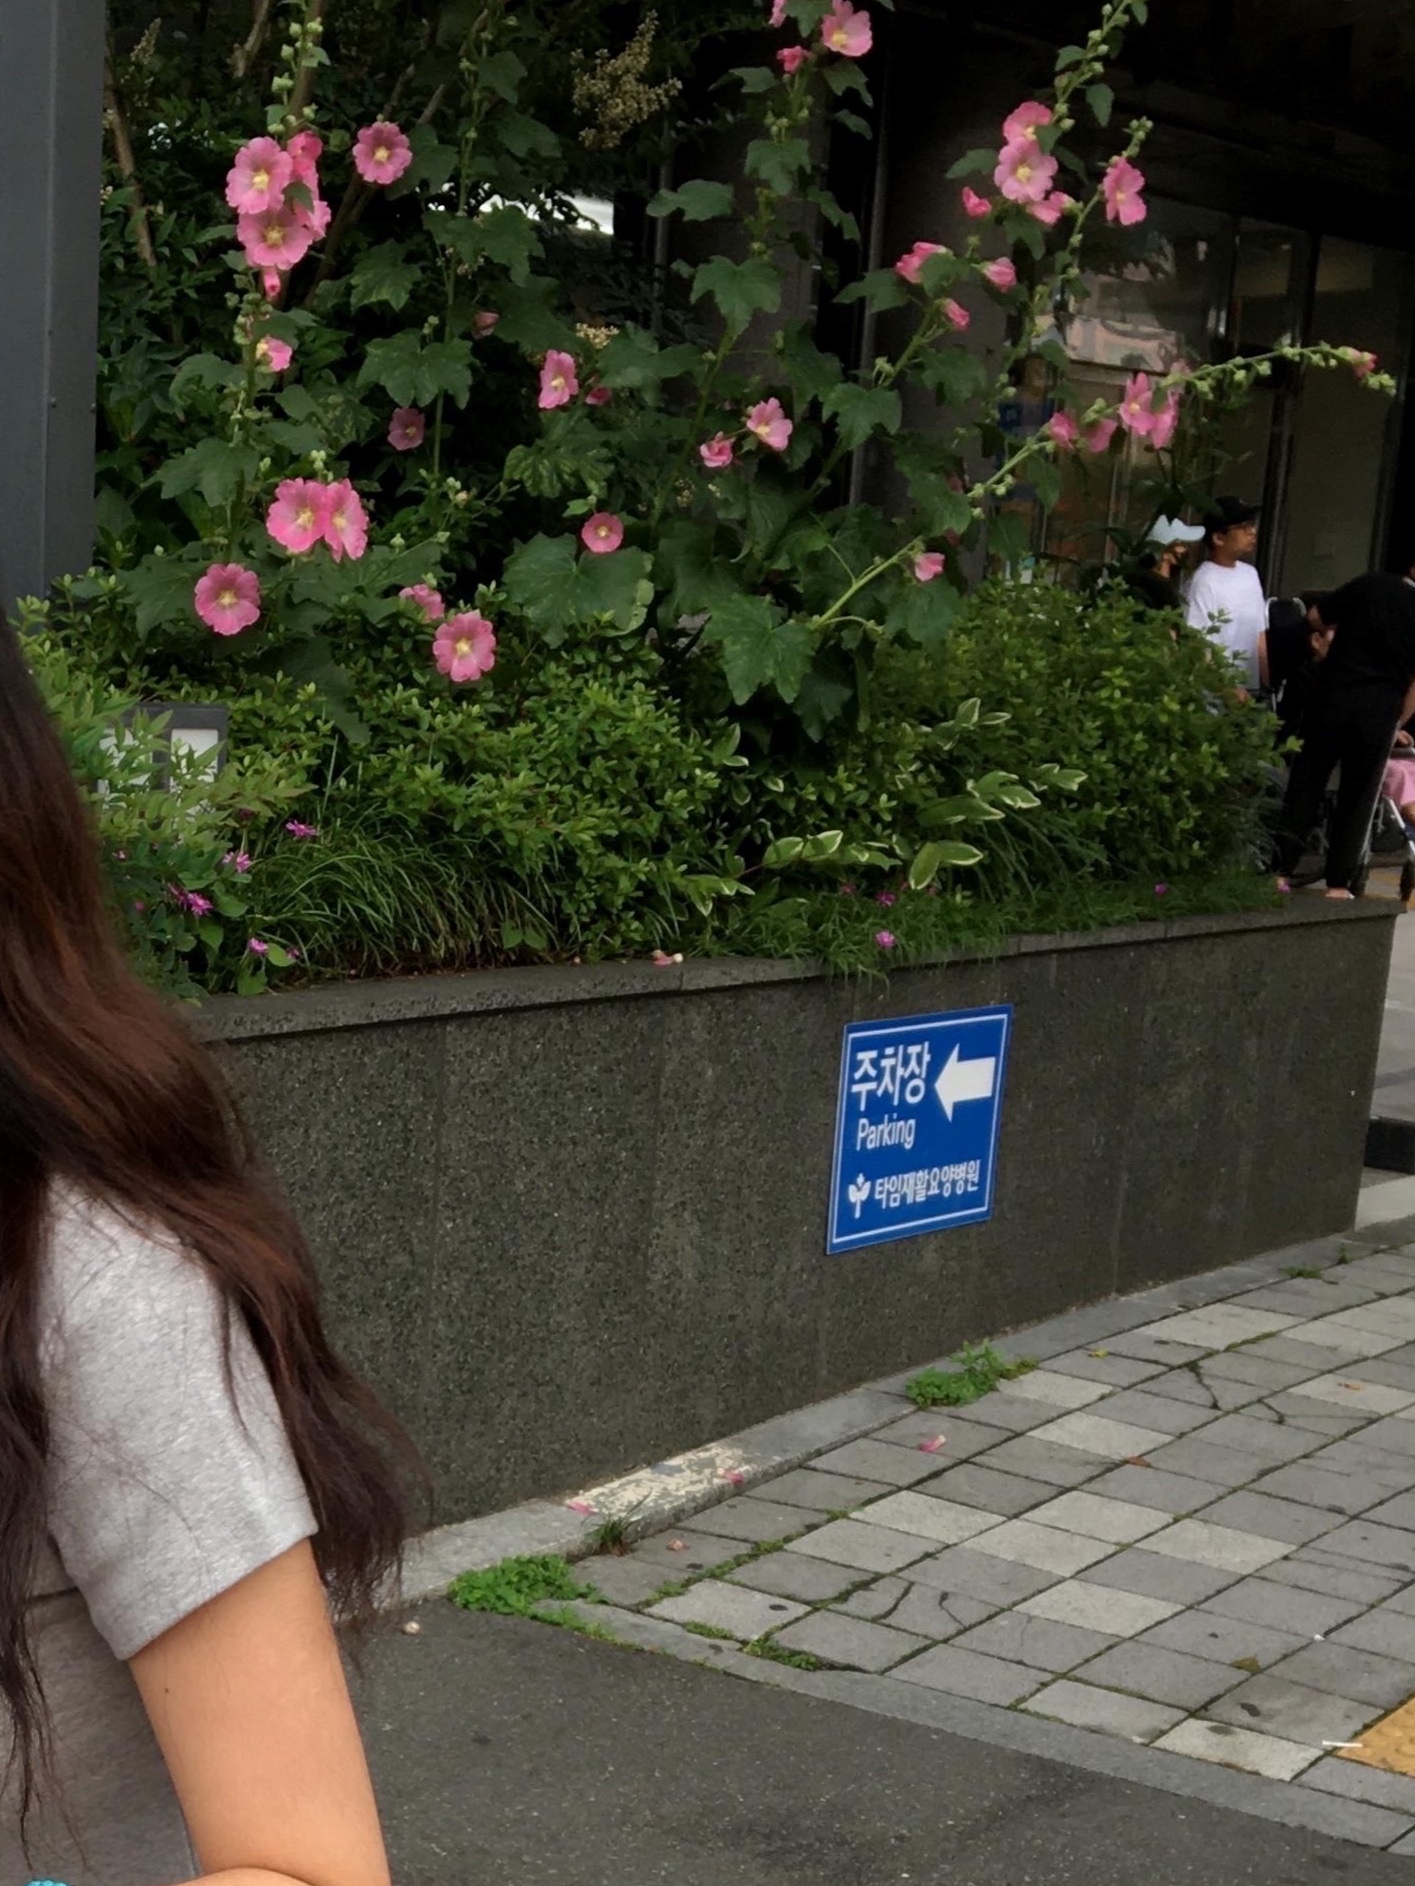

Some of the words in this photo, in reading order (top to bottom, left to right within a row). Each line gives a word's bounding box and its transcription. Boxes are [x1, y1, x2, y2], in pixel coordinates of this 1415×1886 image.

[851, 1041, 931, 1111] 주차장
[856, 1113, 916, 1150] Parking
[874, 1159, 981, 1209] 타임재활요양병원
